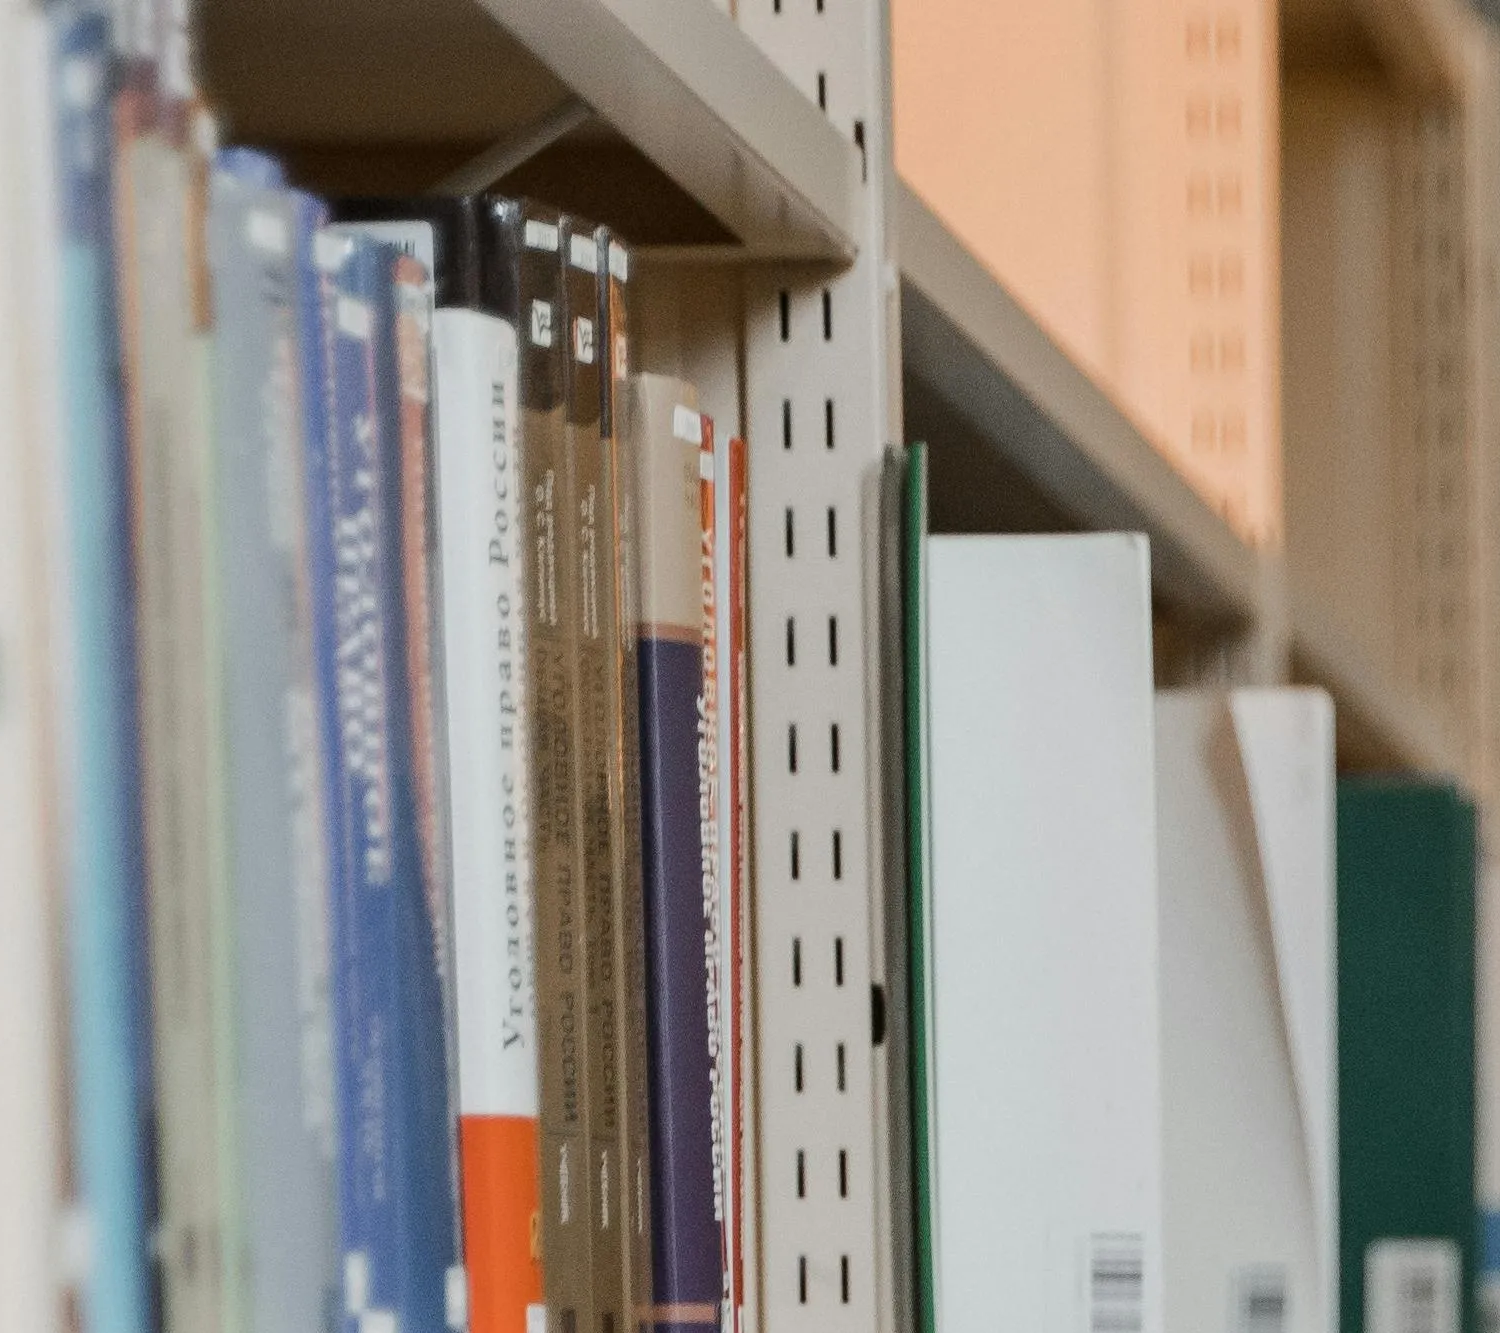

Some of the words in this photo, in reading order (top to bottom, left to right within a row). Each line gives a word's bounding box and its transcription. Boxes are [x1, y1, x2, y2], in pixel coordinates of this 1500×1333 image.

[487, 379, 510, 568] России
[496, 592, 518, 750] право
[499, 773, 527, 1053] Уголовное
[558, 865, 573, 975] ПРАВО
[599, 872, 612, 981] ПРАВО
[561, 991, 579, 1124] РОССИИ
[601, 998, 616, 1127] РОССИИ
